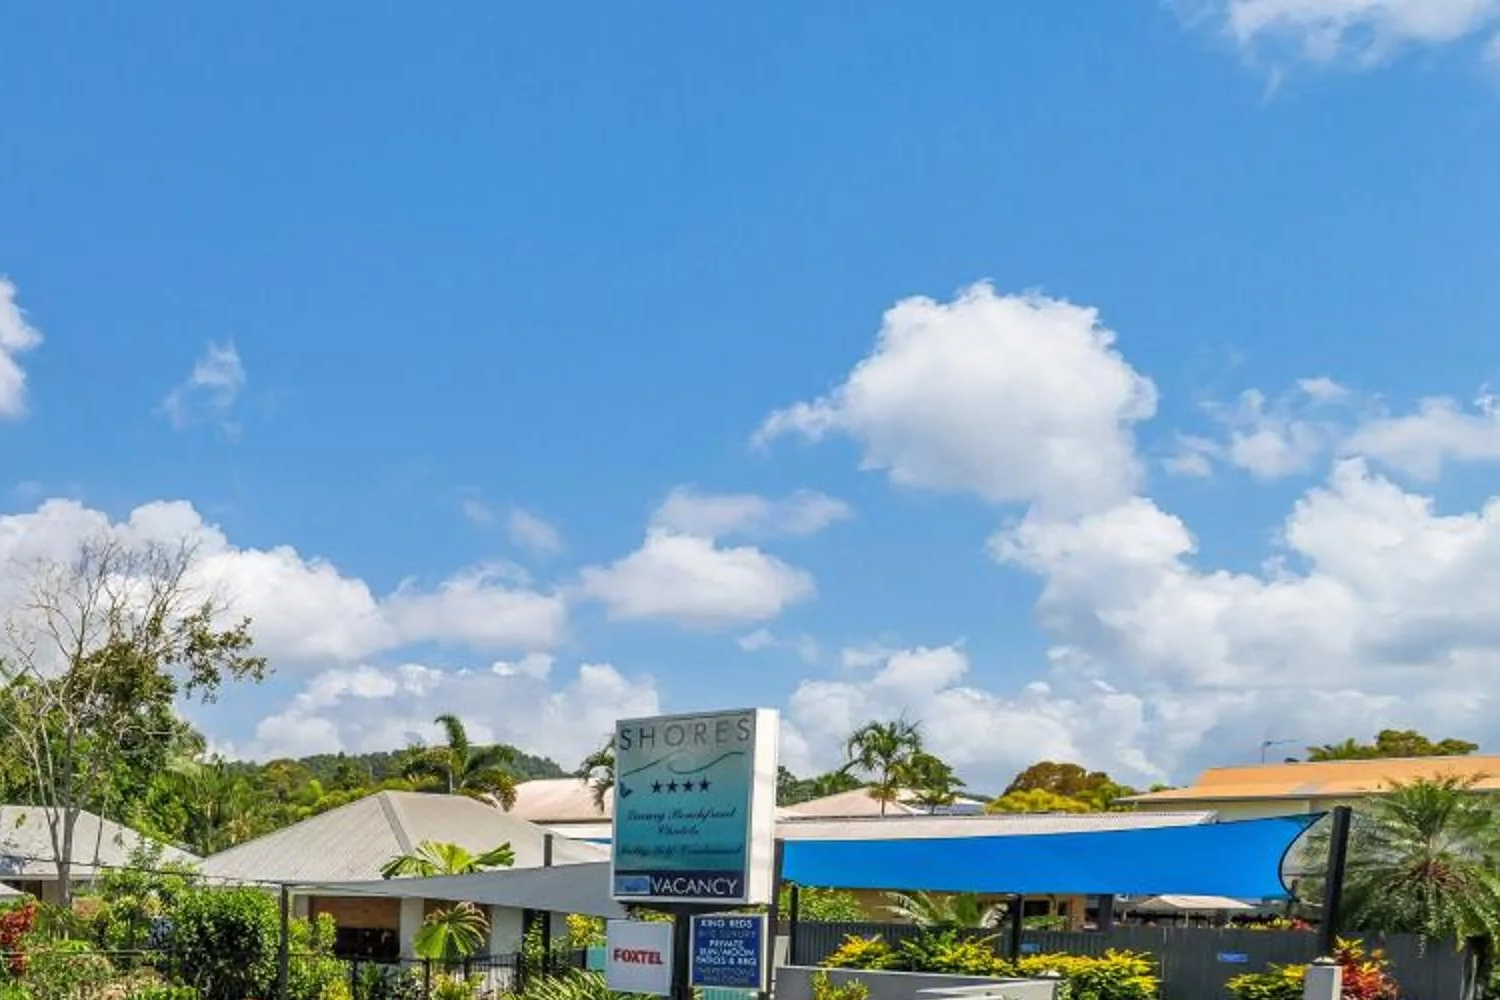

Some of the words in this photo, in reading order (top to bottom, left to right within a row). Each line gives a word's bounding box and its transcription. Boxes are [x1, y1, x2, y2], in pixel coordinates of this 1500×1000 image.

[619, 717, 751, 751] SHORES
[651, 877, 737, 895] VACANCY
[700, 919, 725, 929] KING
[729, 919, 753, 929] BEDS
[709, 939, 745, 949] PRIVATE
[613, 948, 663, 965] FOXTEL
